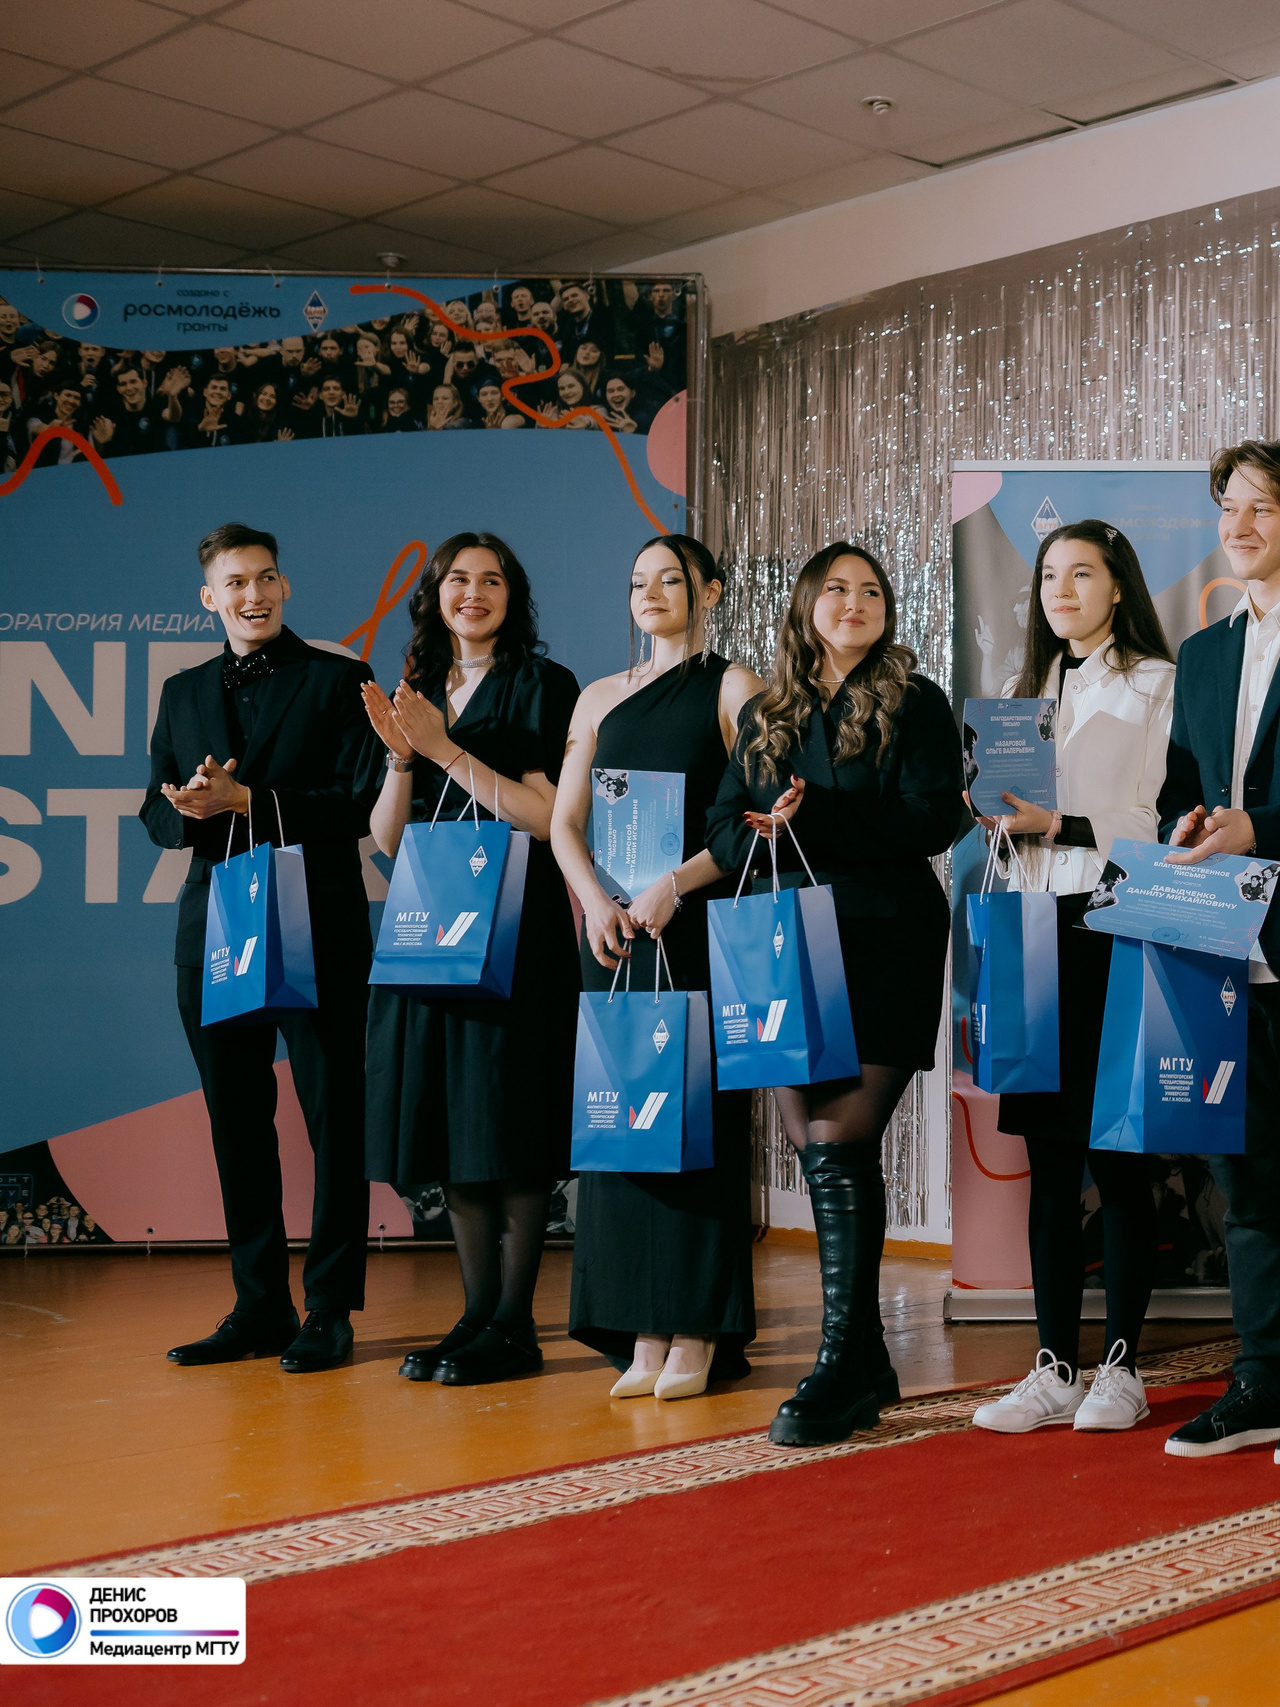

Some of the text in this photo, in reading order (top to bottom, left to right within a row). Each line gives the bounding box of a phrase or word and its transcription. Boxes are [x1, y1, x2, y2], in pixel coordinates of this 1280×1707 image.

[177, 289, 219, 298] создано
[123, 302, 281, 322] росмолодёжь
[177, 322, 228, 333] гранты
[128, 613, 216, 634] МЕДИА
[995, 739, 1026, 747] НАЗАРОВОЙ
[1153, 861, 1230, 878] БЛАГОДАРСТВЕННОЕ
[1174, 869, 1206, 880] ПИСЬМО
[1126, 887, 1237, 910] ДАНИЛУ МИХАЙЛОВИЧУ
[1150, 884, 1216, 900] ДАВЫДЧЕНКО
[396, 911, 430, 922] МГТУ
[211, 946, 230, 962] МГТУ
[722, 1003, 746, 1017] МГТУ
[1160, 1057, 1193, 1071] МГТУ
[587, 1091, 619, 1102] МГТУ
